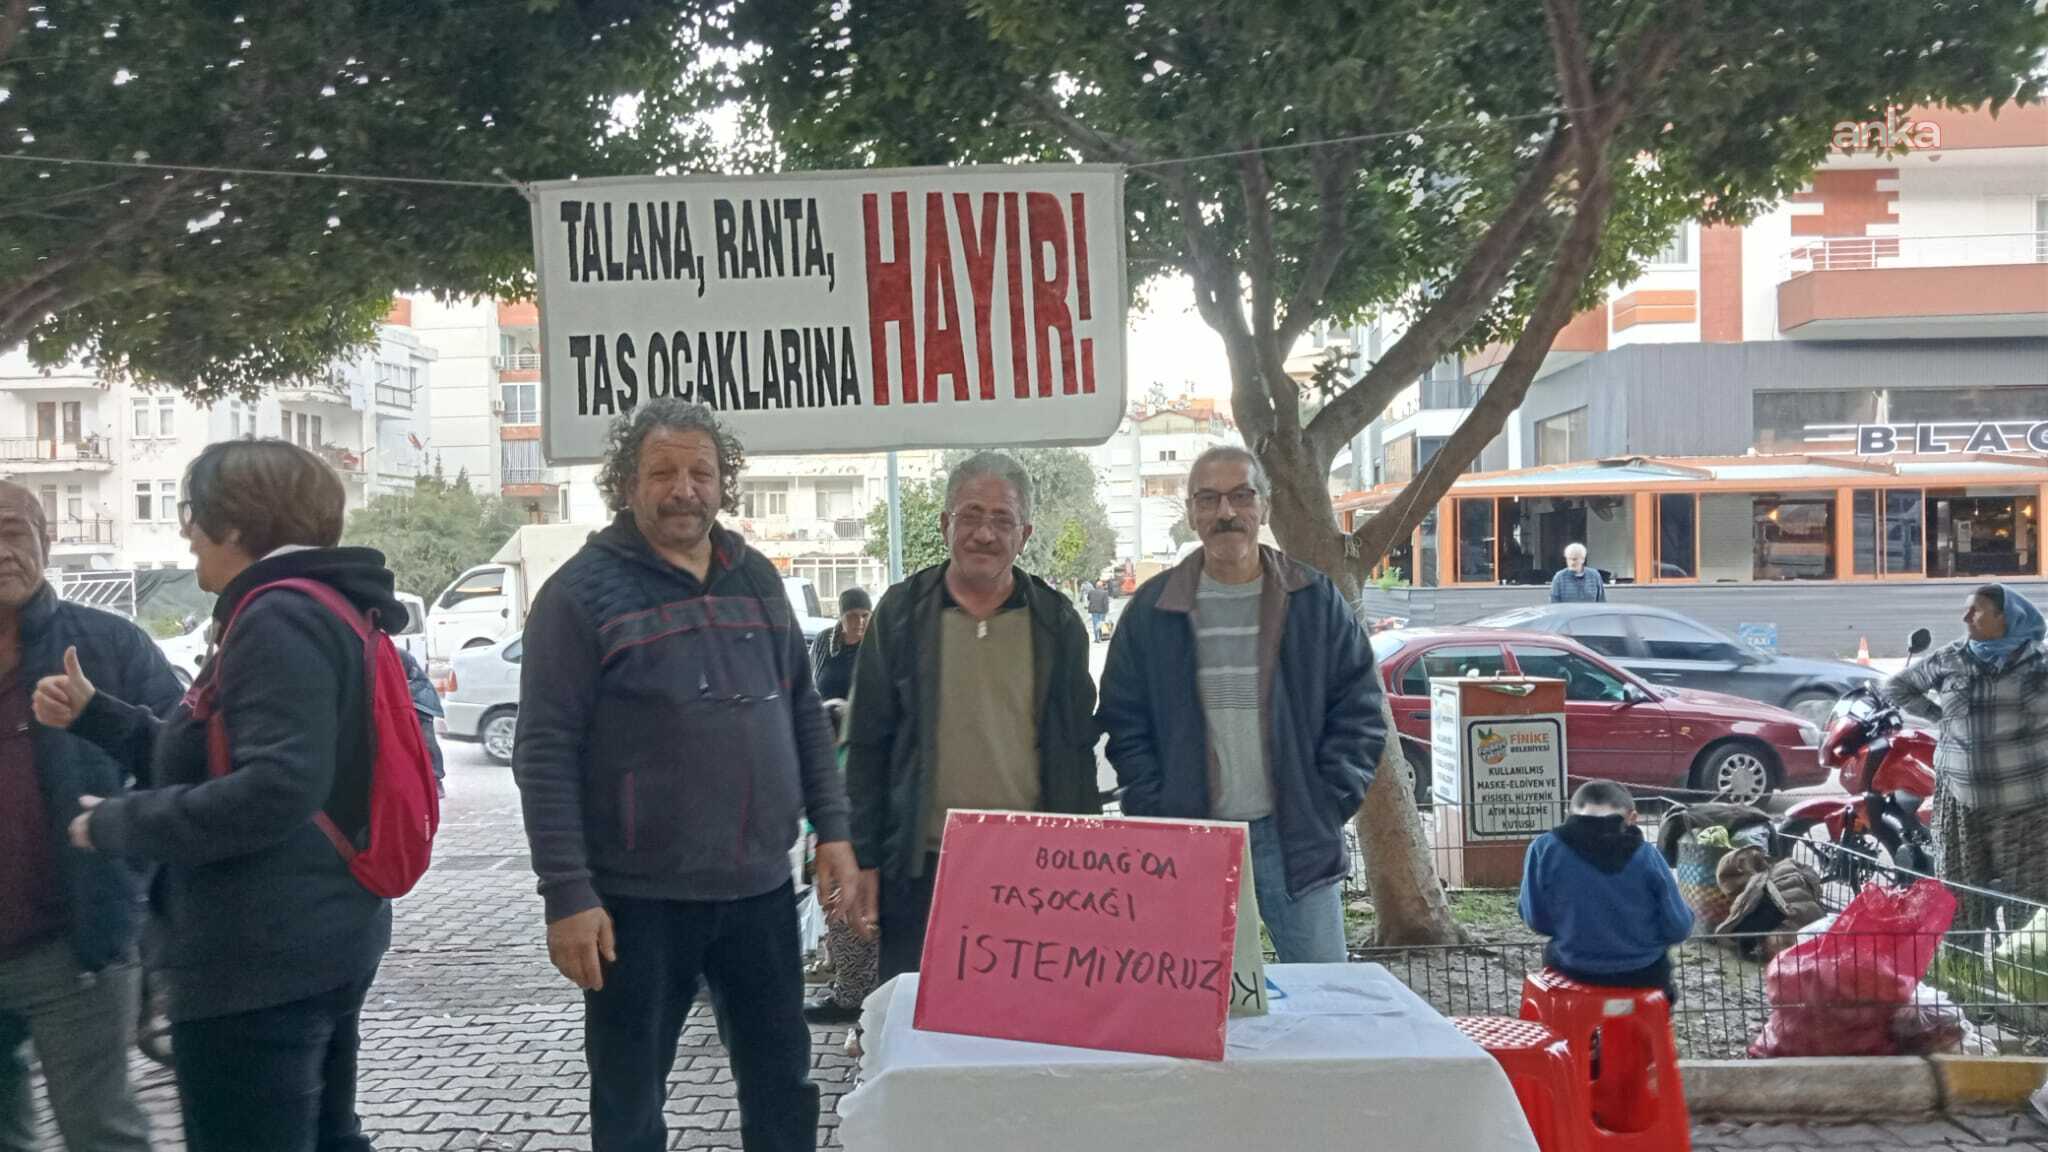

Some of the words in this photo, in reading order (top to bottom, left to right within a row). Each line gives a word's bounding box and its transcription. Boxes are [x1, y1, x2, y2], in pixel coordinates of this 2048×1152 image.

[560, 200, 706, 297] TALANA,
[714, 197, 836, 293] RANTA,
[861, 190, 1096, 406] HAYIR!
[647, 326, 862, 411] OCAKLARINA
[1511, 731, 1550, 744] FİNİKE
[1545, 777, 1557, 788] VE
[1508, 805, 1549, 816] MALZEME
[1502, 820, 1536, 830] KUTUSU
[991, 884, 1136, 922] TAŞOCAĞI
